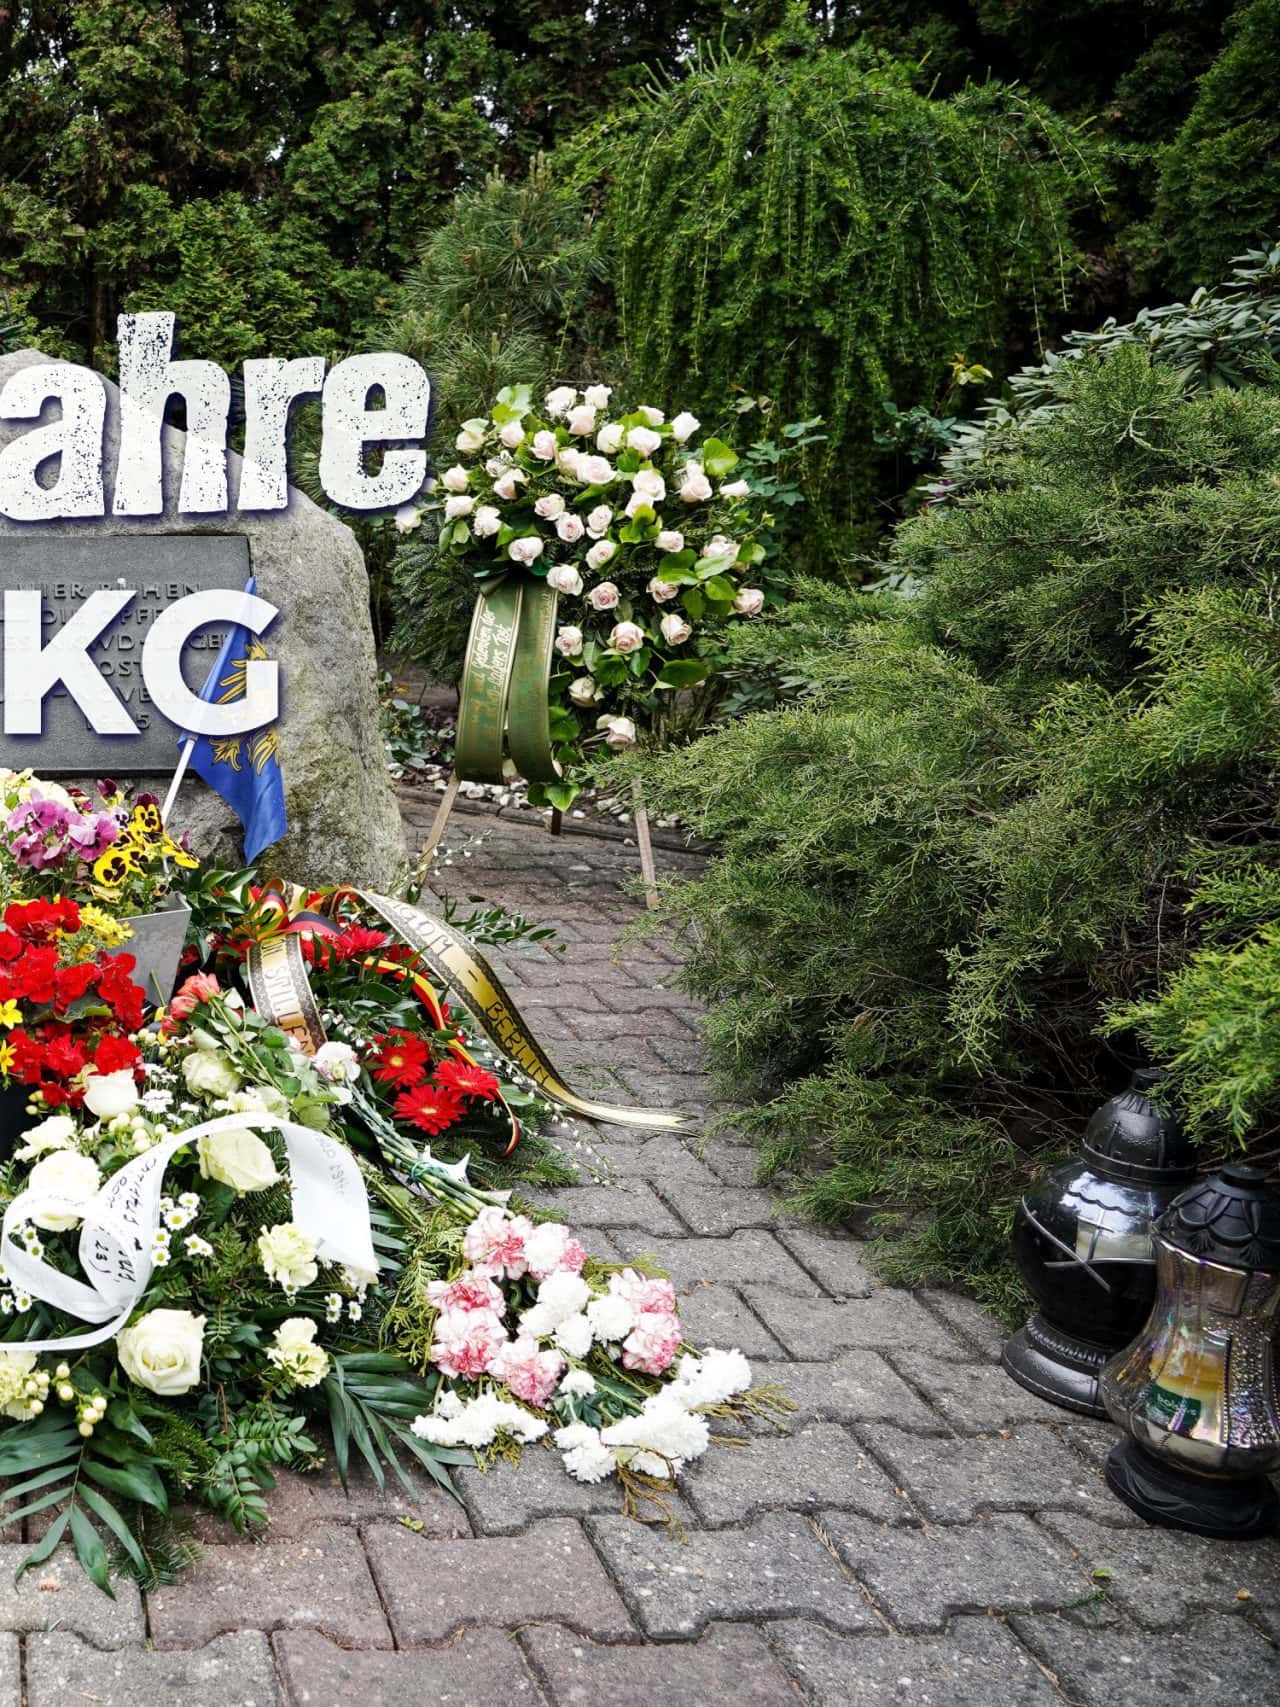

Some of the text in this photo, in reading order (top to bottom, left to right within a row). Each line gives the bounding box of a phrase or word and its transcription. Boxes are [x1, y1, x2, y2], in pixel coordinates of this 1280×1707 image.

[99, 583, 201, 600] RHEN
[83, 660, 147, 678] OST
[486, 1001, 550, 1086] BERLIN
